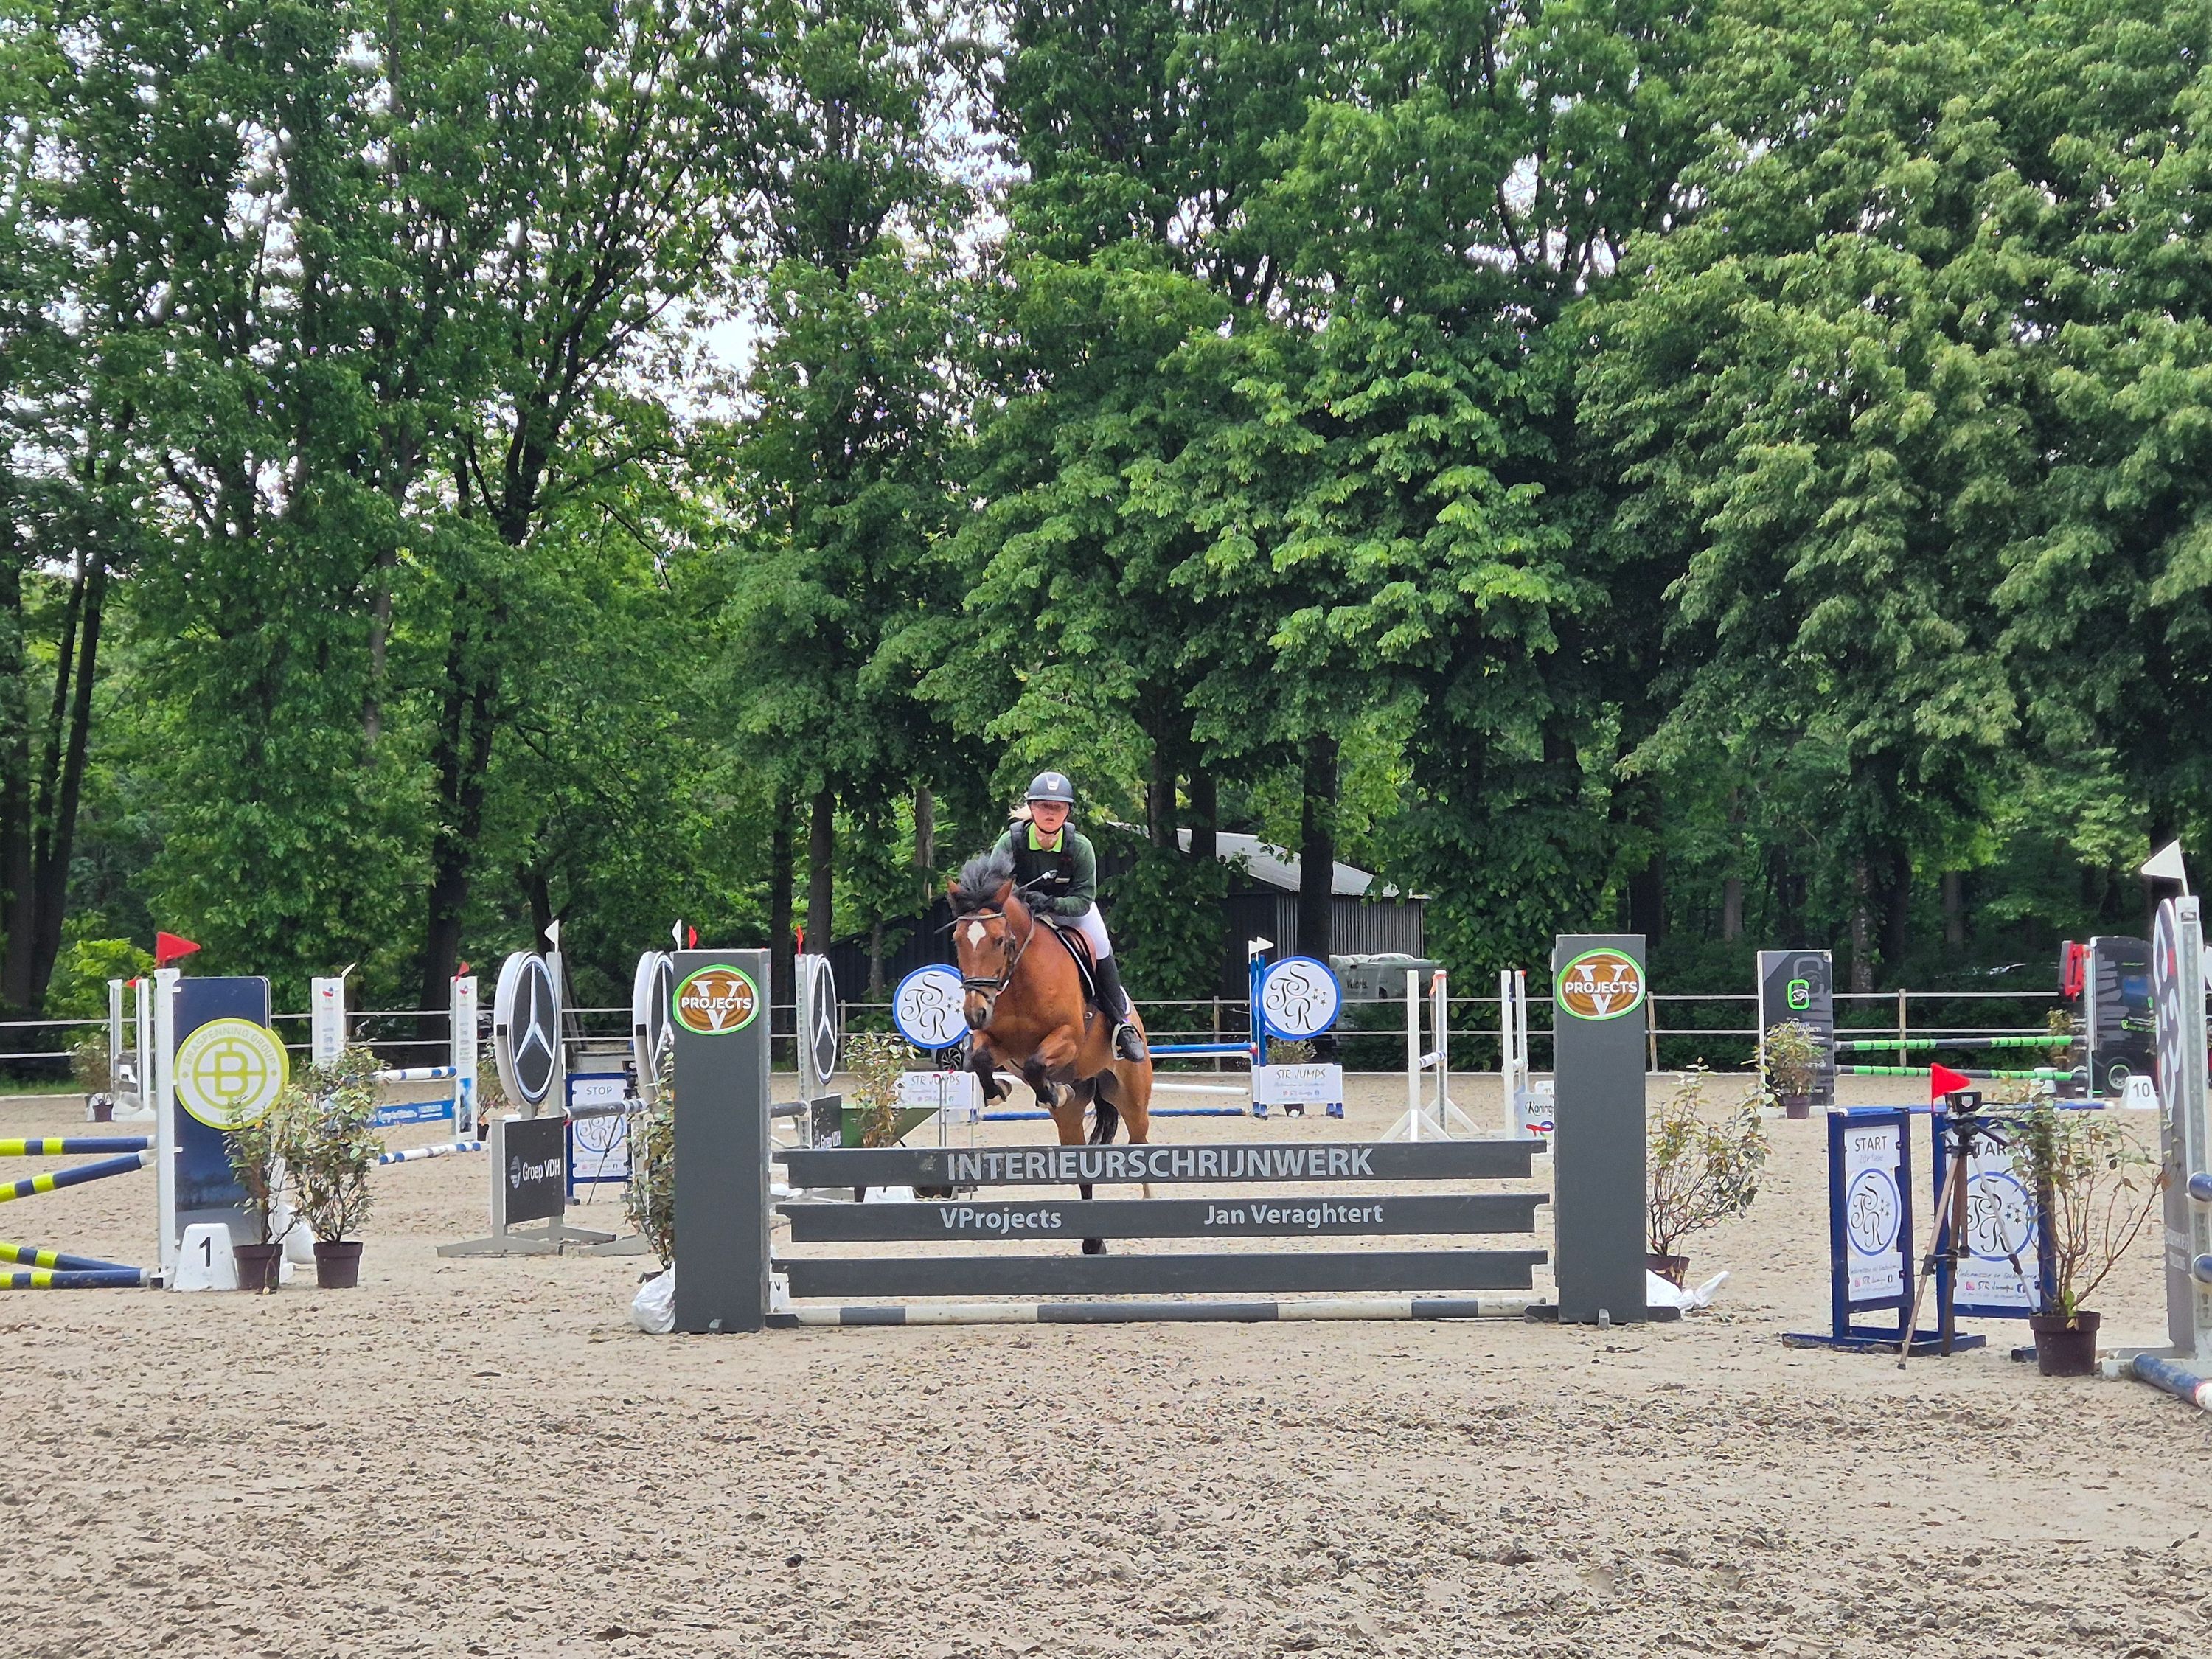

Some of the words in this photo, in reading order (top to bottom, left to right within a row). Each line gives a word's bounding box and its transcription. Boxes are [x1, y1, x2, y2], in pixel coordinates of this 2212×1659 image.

[1565, 981, 1638, 994] PROJECTS
[681, 997, 752, 1009] PROJECTS
[184, 1026, 249, 1065] BRASPENNING
[250, 1033, 276, 1064] GROUP
[1295, 1068, 1326, 1079] JUMPS
[586, 1086, 613, 1096] STOP
[2132, 1082, 2150, 1098] 10
[1854, 1135, 1888, 1152] START
[522, 1161, 543, 1184] Groep
[544, 1158, 561, 1178] VDH
[947, 1147, 1374, 1180] INTERIEURSCHRIJNWERK
[939, 1206, 1062, 1234] VProjects
[1203, 1205, 1245, 1225] Jan
[1250, 1202, 1383, 1229] Veraghtert
[199, 1237, 211, 1267] 1
